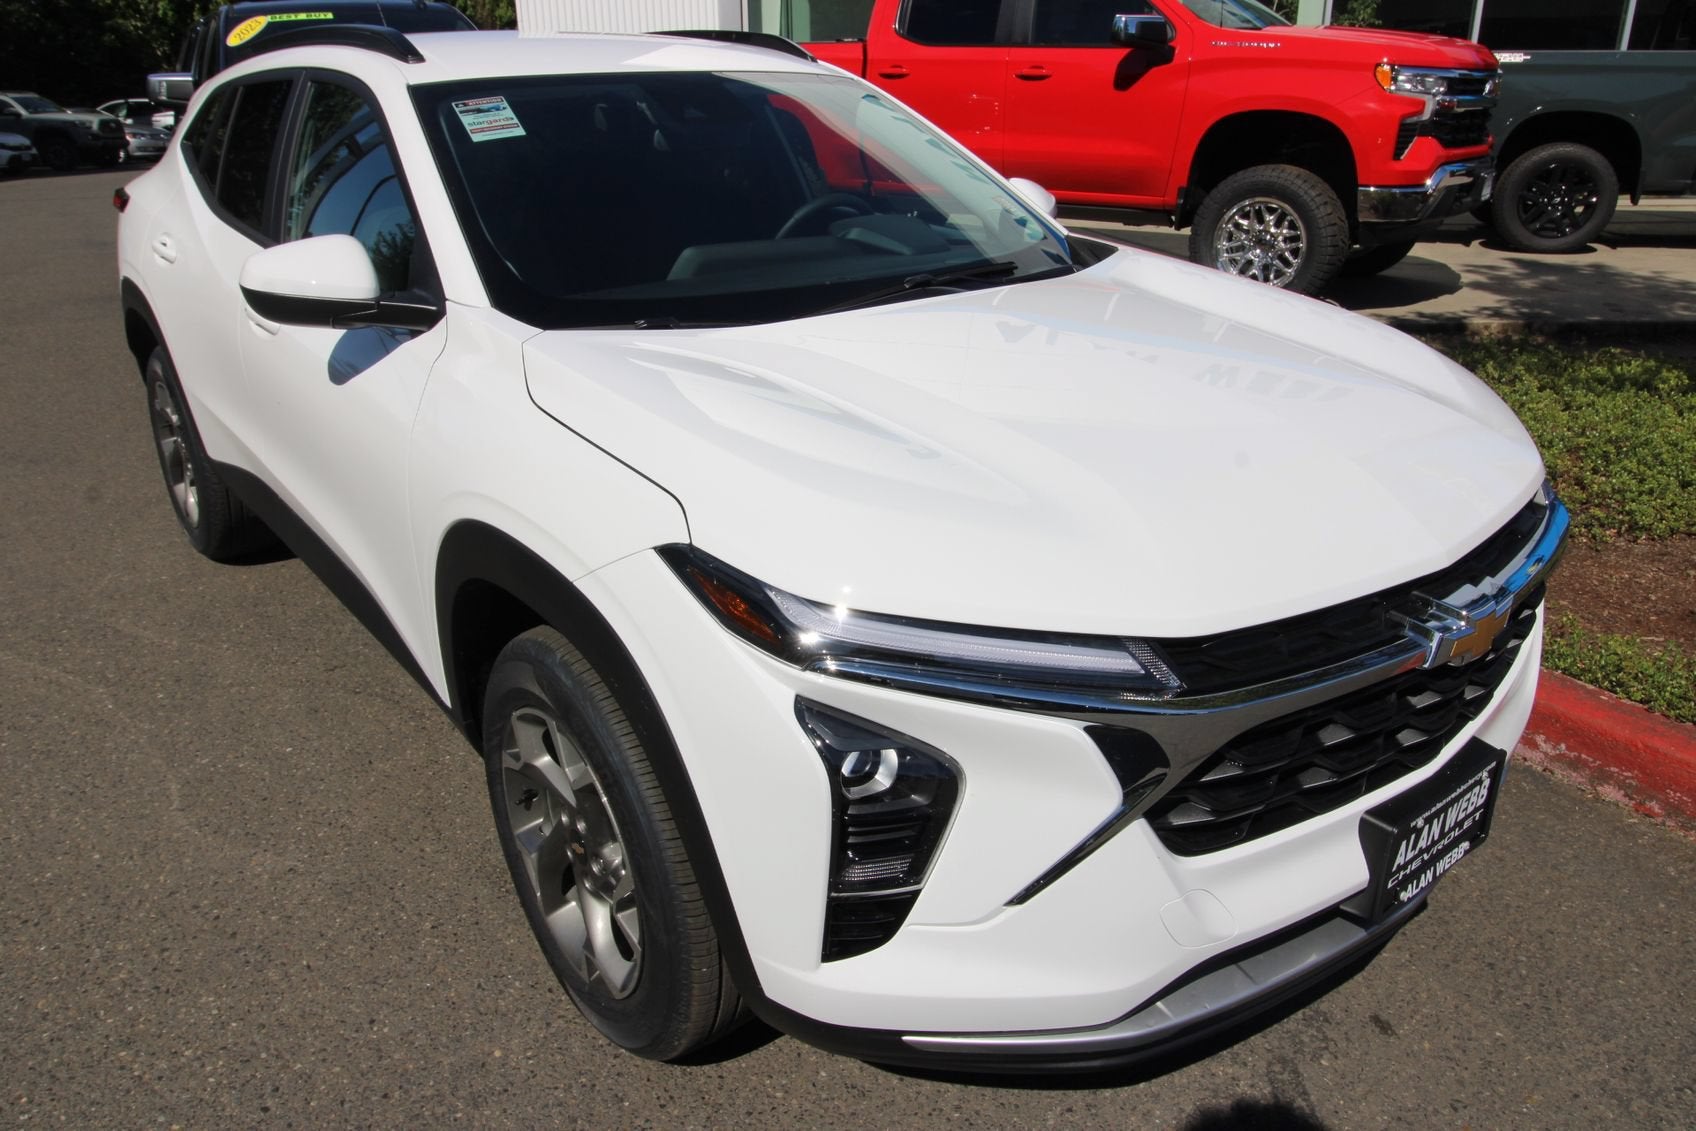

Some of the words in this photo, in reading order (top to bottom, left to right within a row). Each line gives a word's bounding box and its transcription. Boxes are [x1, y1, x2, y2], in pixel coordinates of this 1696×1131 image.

[234, 19, 263, 41] 2023
[1387, 808, 1484, 889] CHEVROLET
[1392, 813, 1445, 872] ALAN
[1445, 777, 1491, 833] WEBB
[1404, 866, 1434, 902] ALAN
[1435, 846, 1465, 877] WEBB
